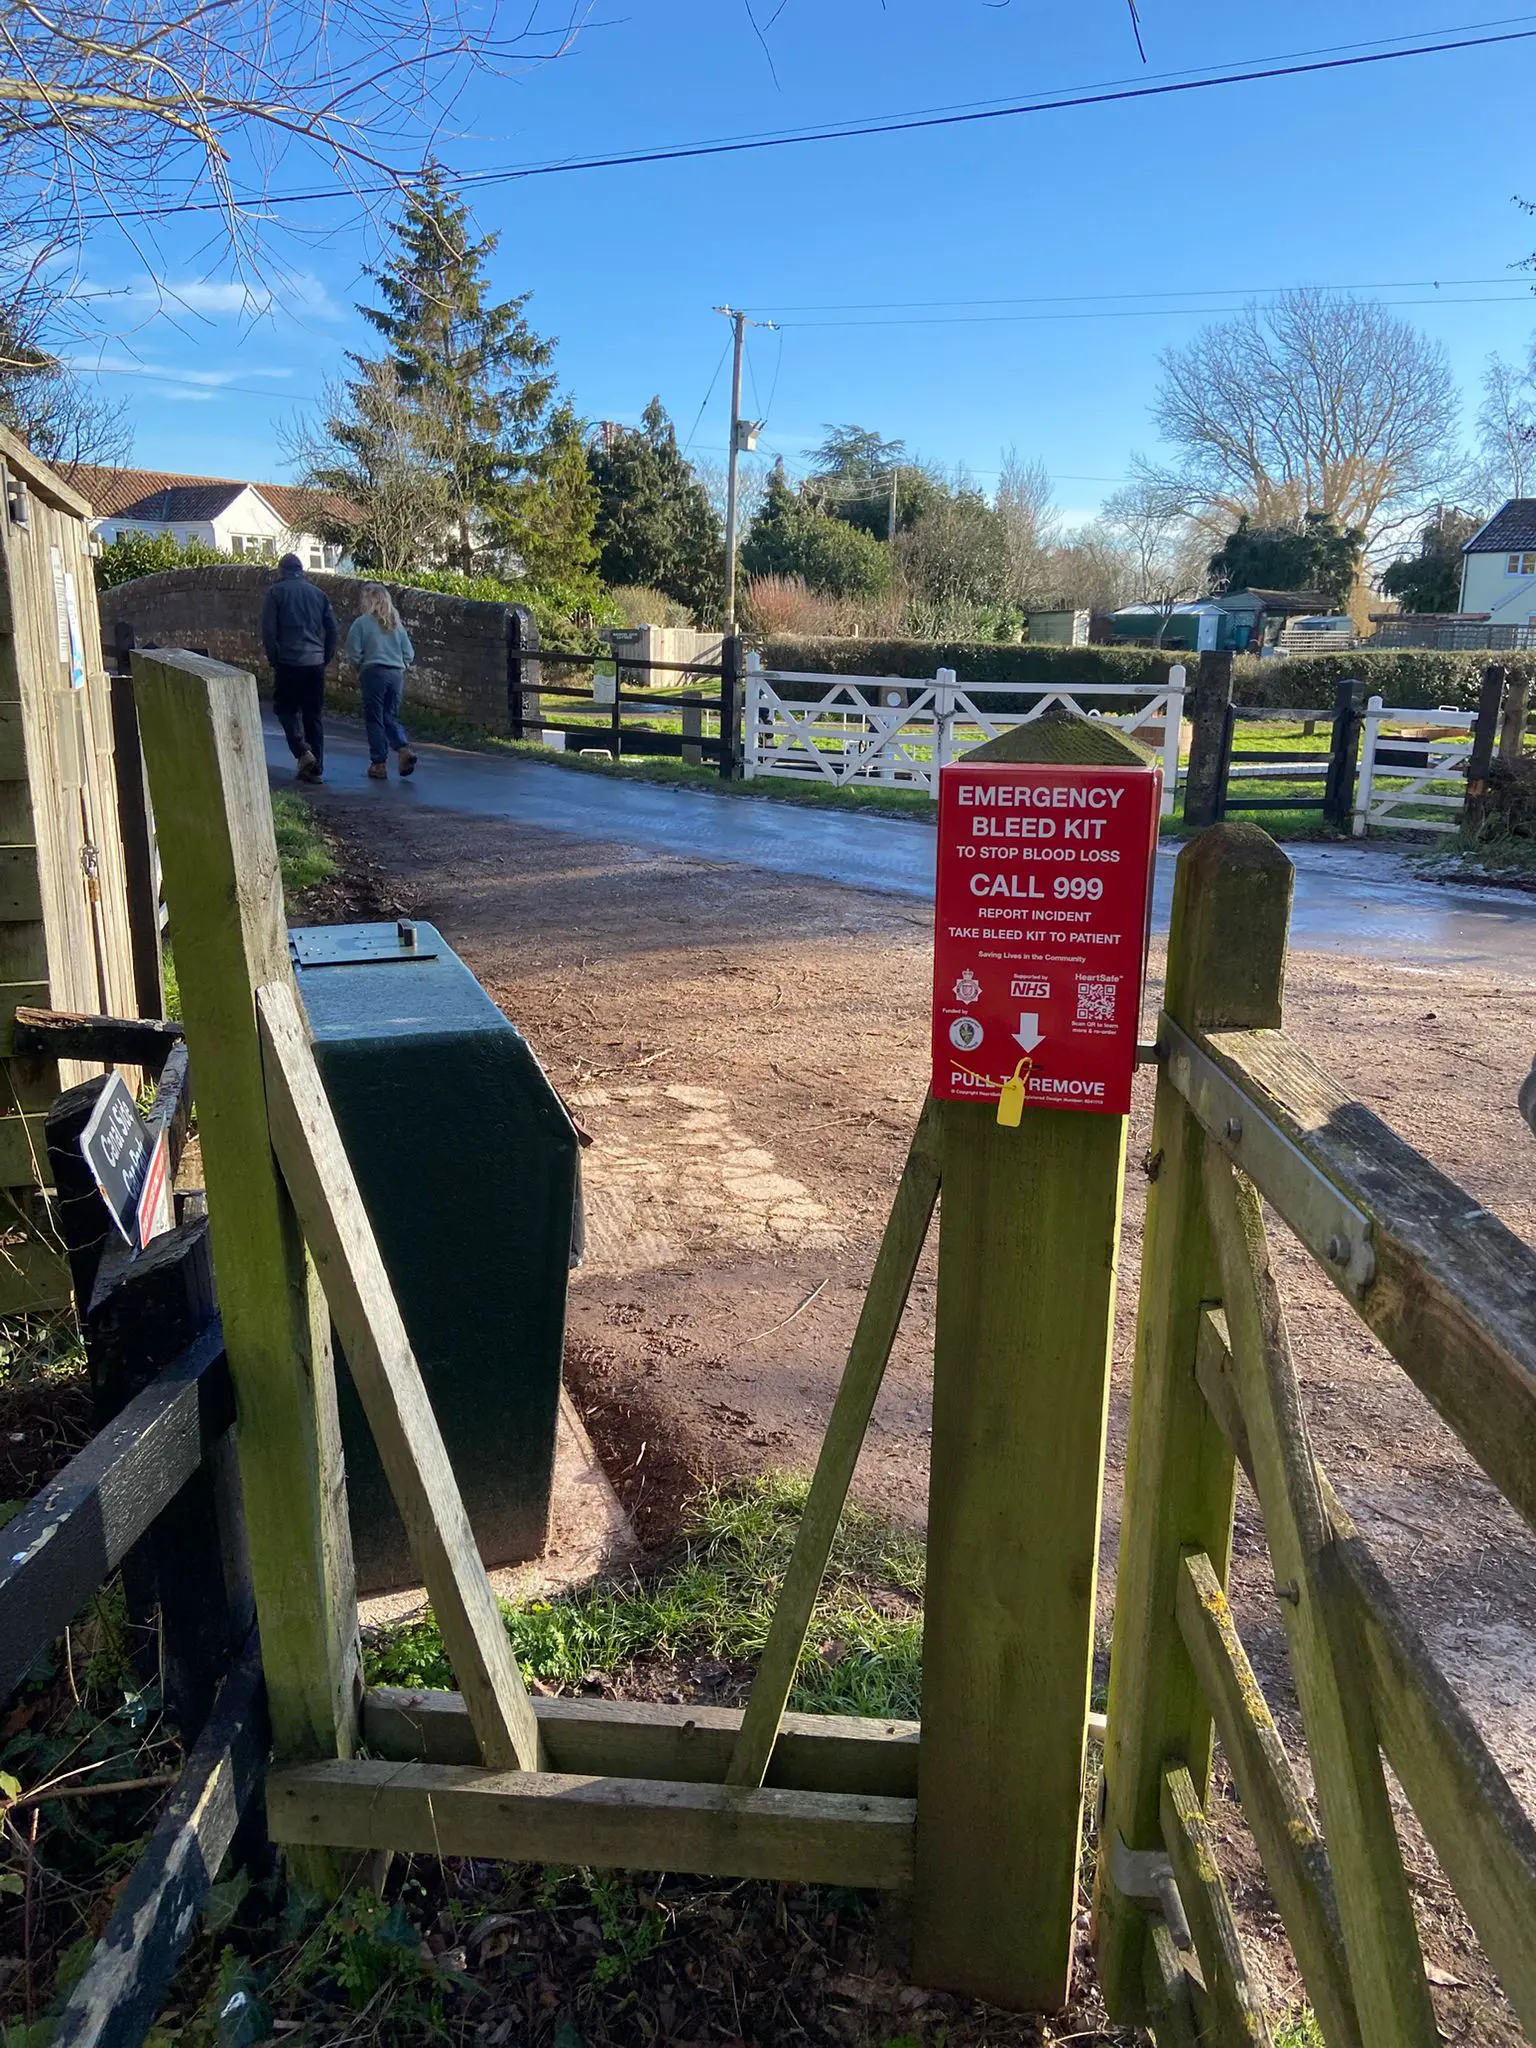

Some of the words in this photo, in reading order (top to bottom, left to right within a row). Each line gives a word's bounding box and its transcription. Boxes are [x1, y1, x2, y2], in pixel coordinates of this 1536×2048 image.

[958, 785, 1124, 809] EMERGENCY
[972, 816, 1056, 839] BLEED
[1064, 819, 1107, 840] KIT
[956, 845, 976, 858] TO
[979, 847, 1019, 860] STOP
[1023, 848, 1076, 862] BLOOD
[1080, 850, 1121, 863] LOSS
[969, 873, 1045, 898] CALL
[1053, 876, 1104, 900] 999
[978, 907, 1029, 920] REPORT
[1032, 910, 1092, 922] INCIDENT
[948, 927, 980, 938] TAKE
[982, 929, 1023, 941] BLEED
[1026, 930, 1046, 942] KIT
[1049, 931, 1066, 942] TO
[1069, 933, 1122, 945] PATIENT
[978, 950, 1002, 959] Saving
[1003, 951, 1022, 960] Lives
[1023, 952, 1030, 960] in
[1032, 953, 1043, 961] the
[1045, 954, 1086, 963] Community
[1012, 982, 1048, 997] NHS
[951, 1071, 995, 1088] PULL
[1028, 1077, 1105, 1096] REMOVE
[112, 1097, 135, 1136] Side
[100, 1115, 125, 1168] Canal
